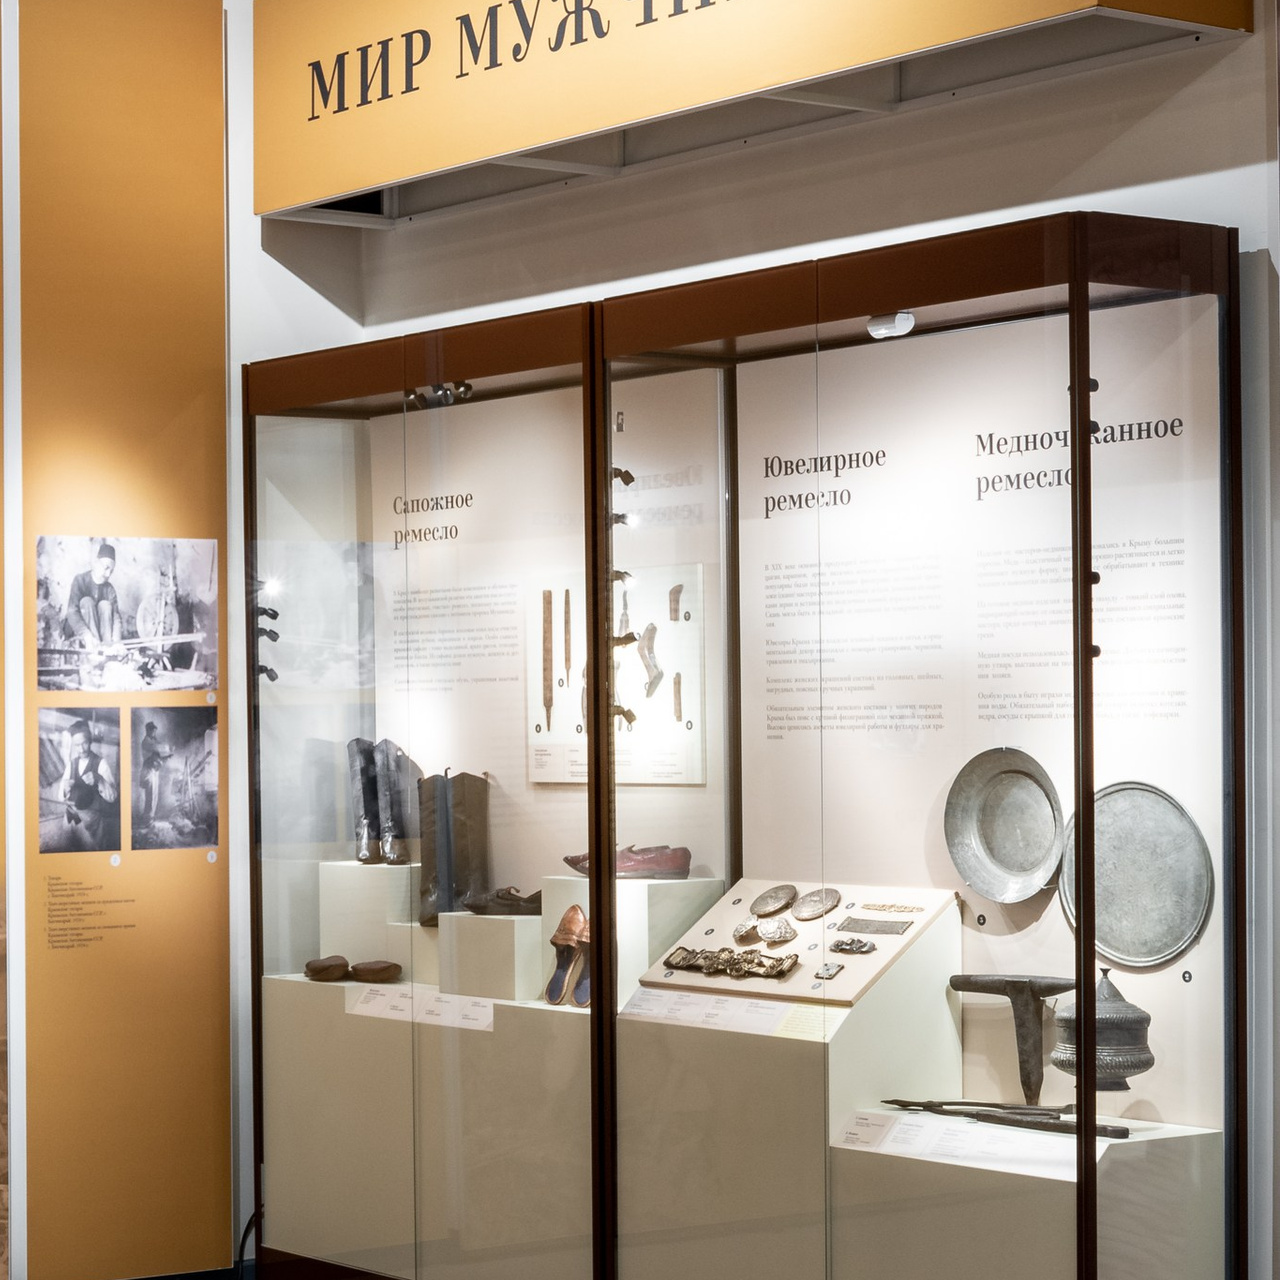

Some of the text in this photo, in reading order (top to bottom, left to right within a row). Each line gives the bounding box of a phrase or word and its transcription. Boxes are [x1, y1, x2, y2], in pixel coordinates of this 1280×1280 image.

[307, 28, 432, 121] МИР
[763, 444, 887, 479] Ювелирное
[393, 492, 474, 517] Сапожное
[763, 487, 852, 519] ремесло
[393, 524, 458, 550] ремесло
